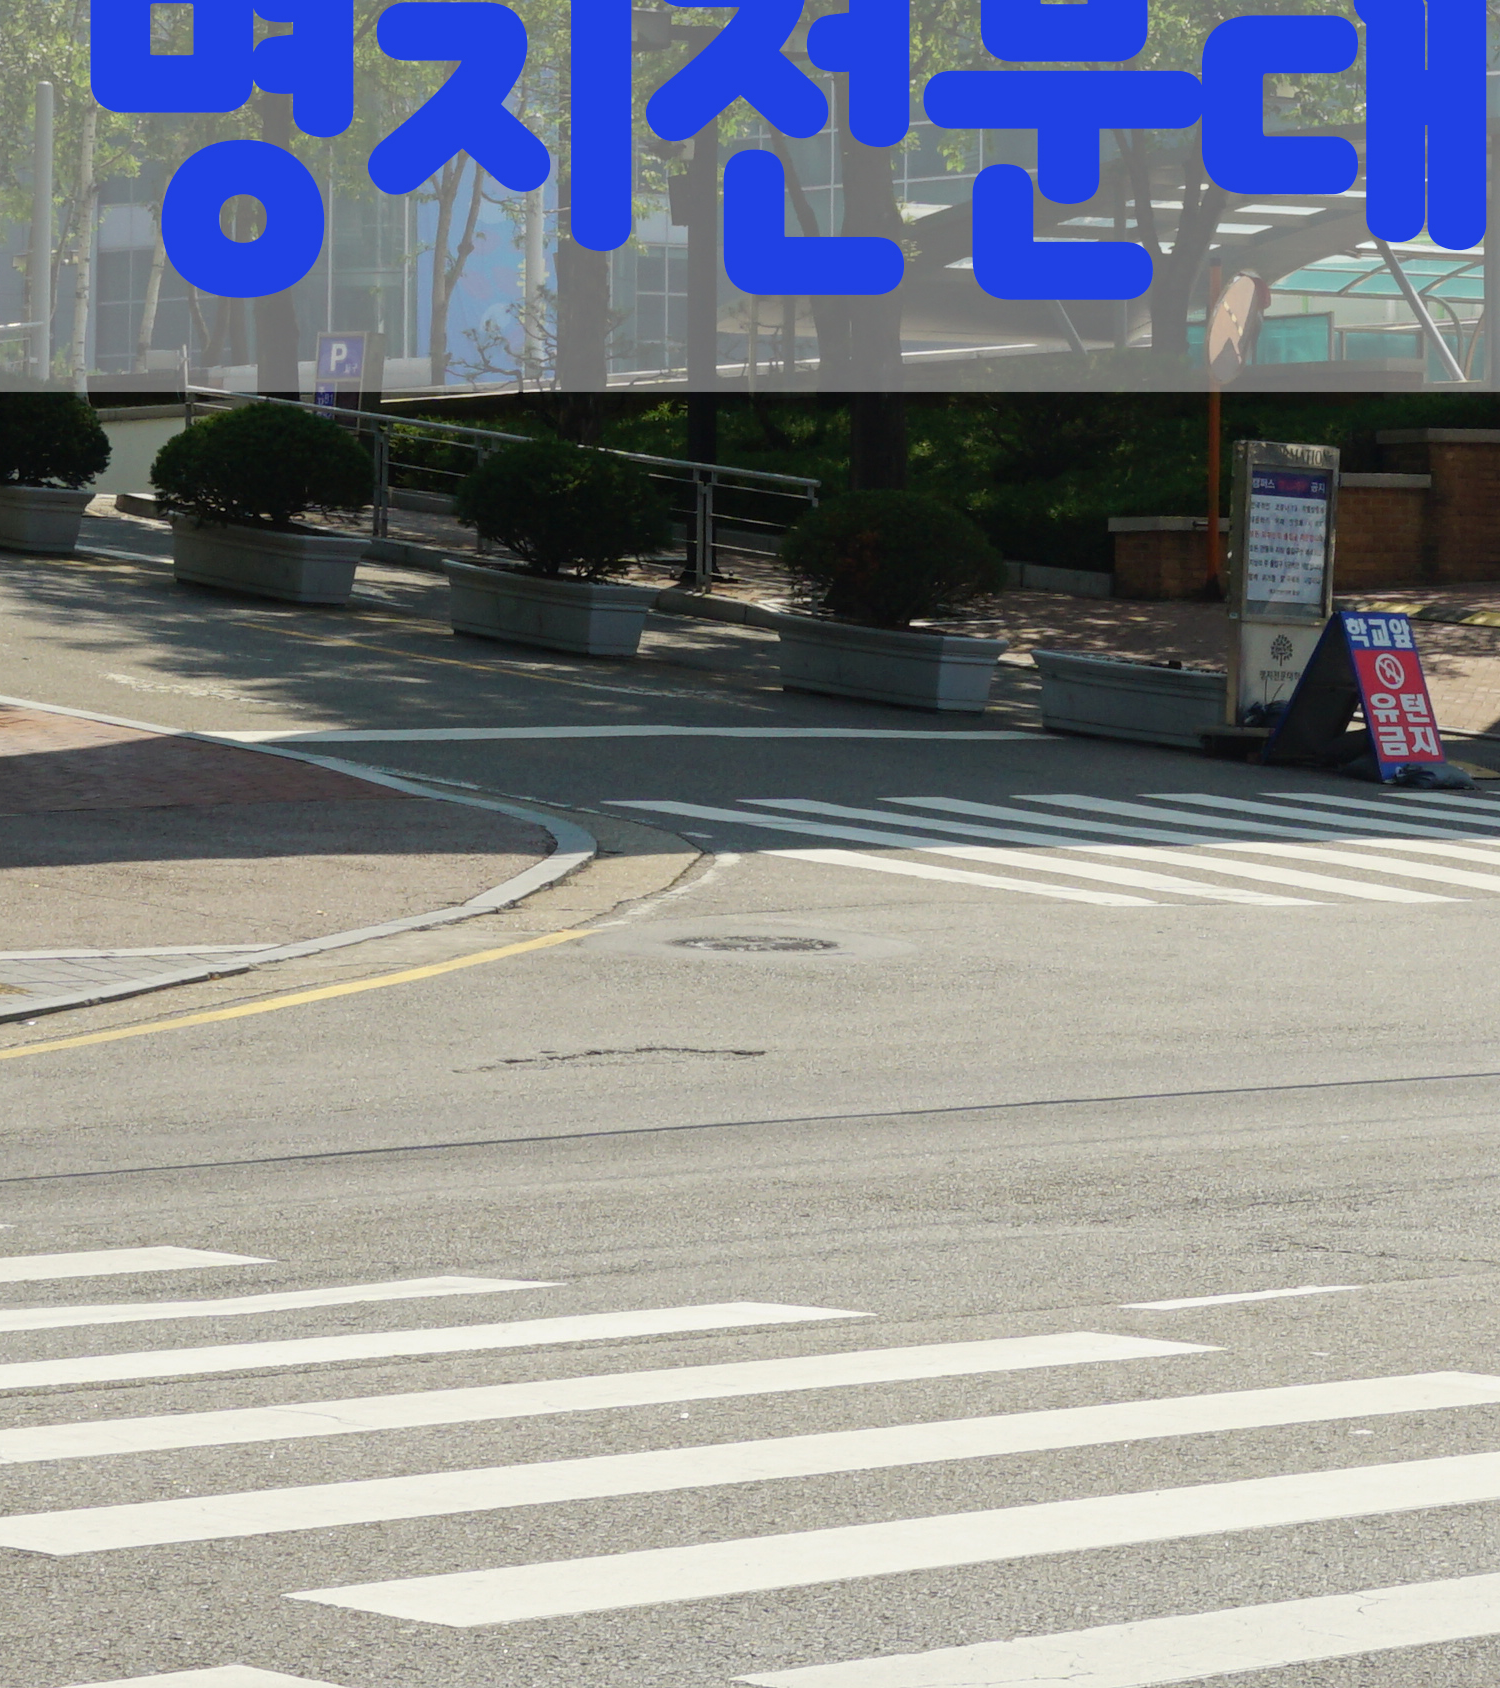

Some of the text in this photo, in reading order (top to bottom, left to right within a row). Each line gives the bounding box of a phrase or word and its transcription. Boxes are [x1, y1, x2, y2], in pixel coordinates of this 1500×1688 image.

[330, 343, 347, 371] P
[1345, 618, 1414, 649] 학교앞
[1370, 693, 1431, 724] 유턴
[1377, 725, 1440, 756] 금지
